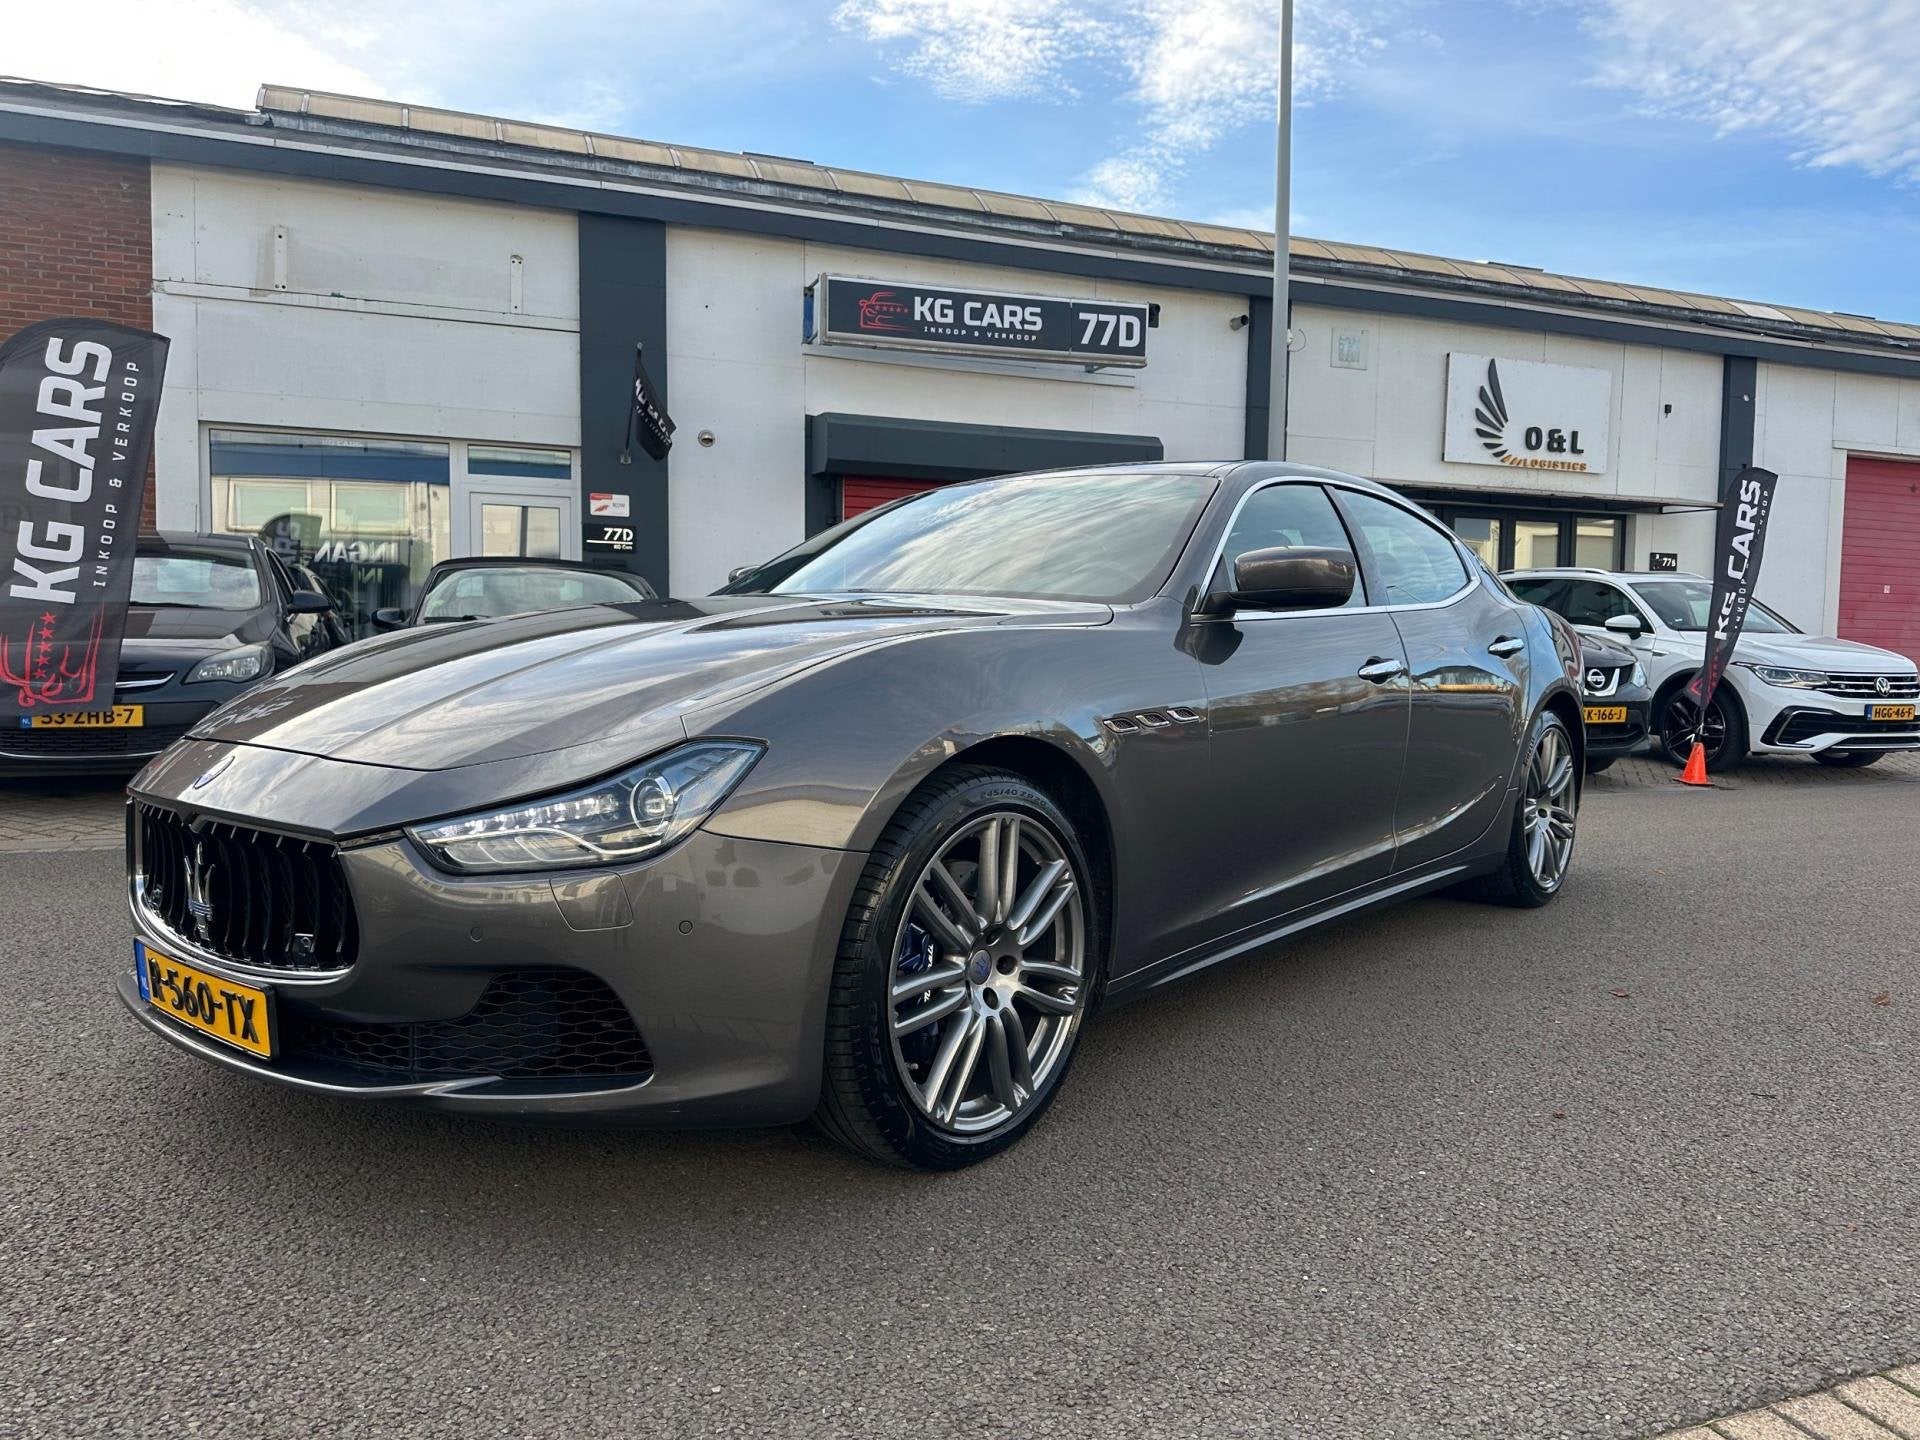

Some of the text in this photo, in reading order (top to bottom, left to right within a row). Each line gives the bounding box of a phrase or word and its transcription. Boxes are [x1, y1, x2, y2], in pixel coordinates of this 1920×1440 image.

[914, 296, 1043, 331] KG CARS
[924, 326, 968, 336] INKOOP
[987, 332, 1038, 342] VERKOOP
[1078, 312, 1141, 348] 77D
[9, 337, 113, 604] KG CARS
[1523, 459, 1587, 471] LOGISTICS
[93, 361, 139, 588] INKOOP & VERKOOP
[604, 527, 634, 541] 77D
[1714, 479, 1761, 640] KG CARS
[41, 708, 135, 725] 53-ZHB-7
[1584, 708, 1622, 721] K-166-J
[1874, 707, 1913, 719] HGG-46-F
